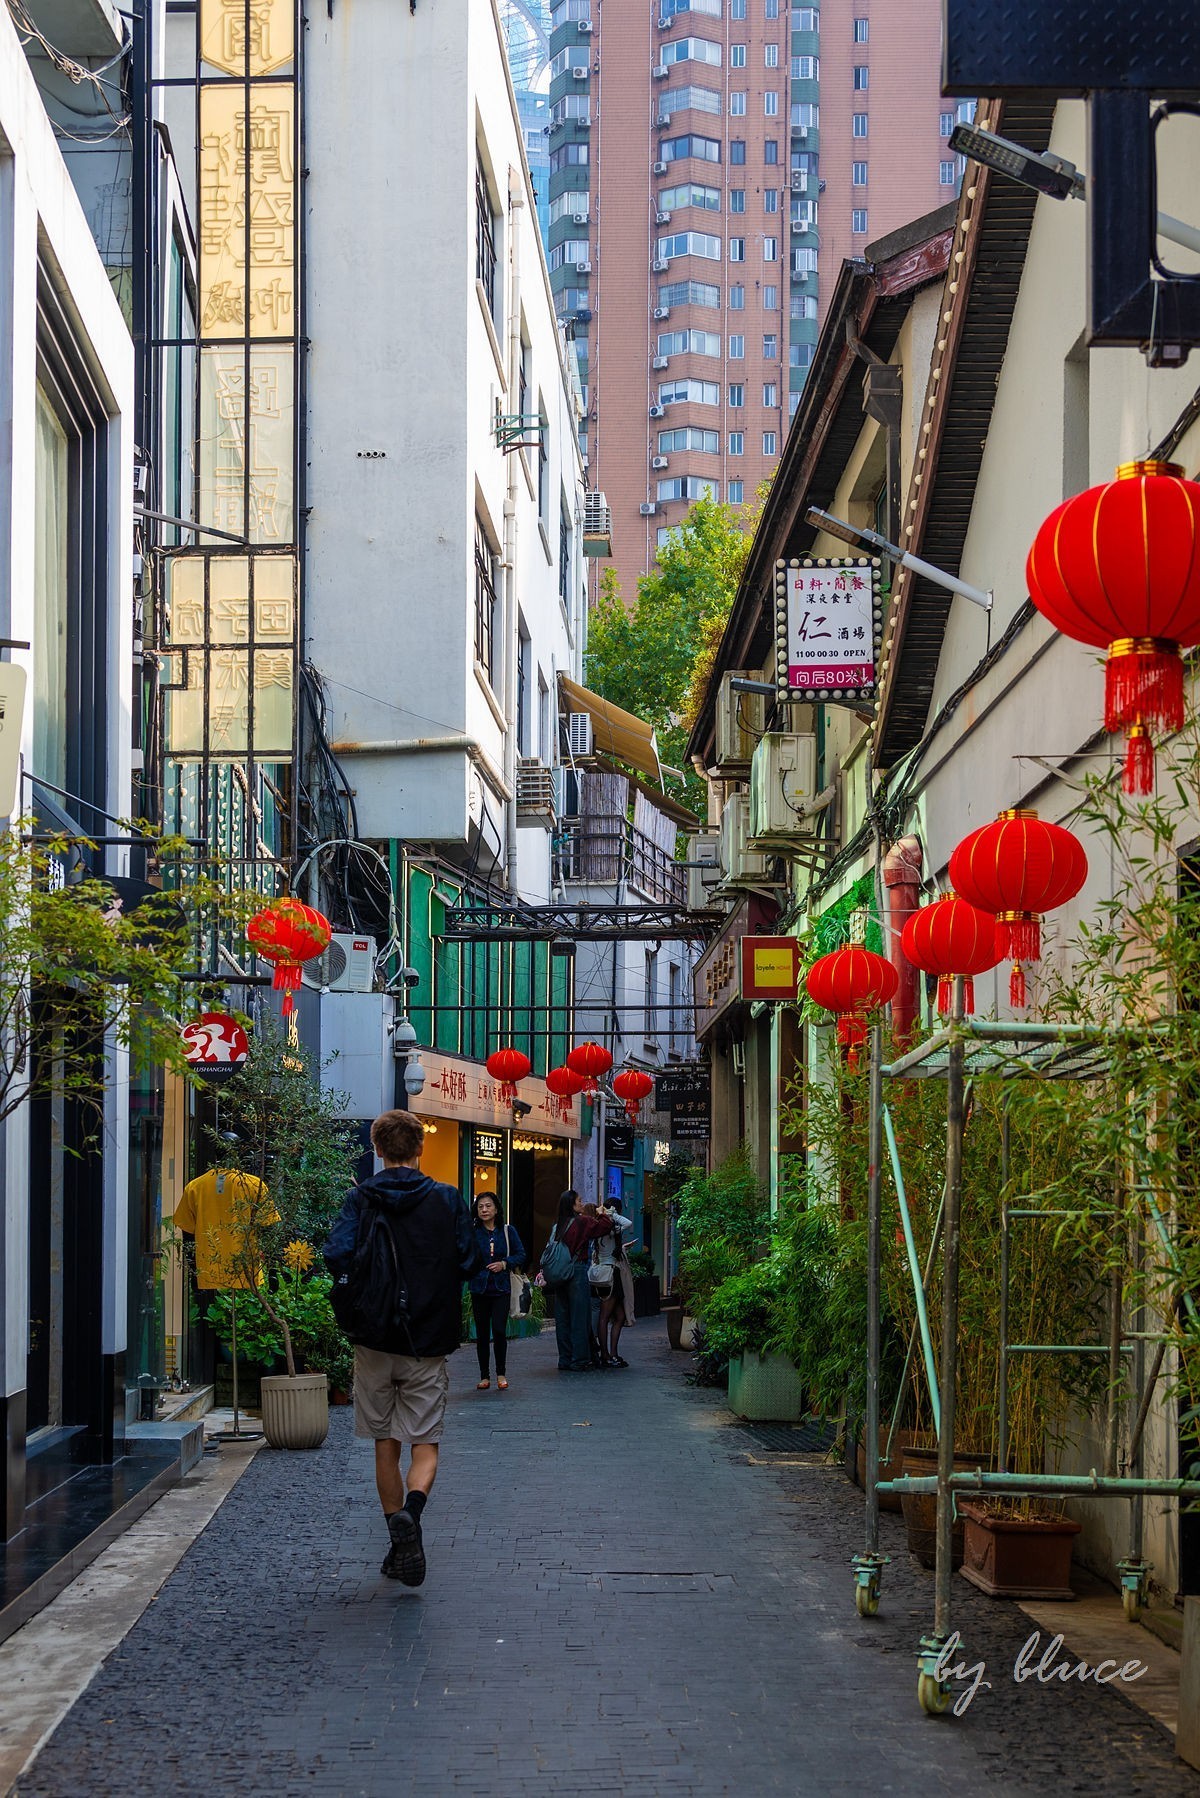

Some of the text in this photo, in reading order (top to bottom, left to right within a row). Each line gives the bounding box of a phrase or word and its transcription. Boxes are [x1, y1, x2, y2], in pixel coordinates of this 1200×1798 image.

[806, 593, 853, 605] 深夜食堂
[798, 611, 866, 642] 仁 酒場
[843, 649, 867, 658] OPEN
